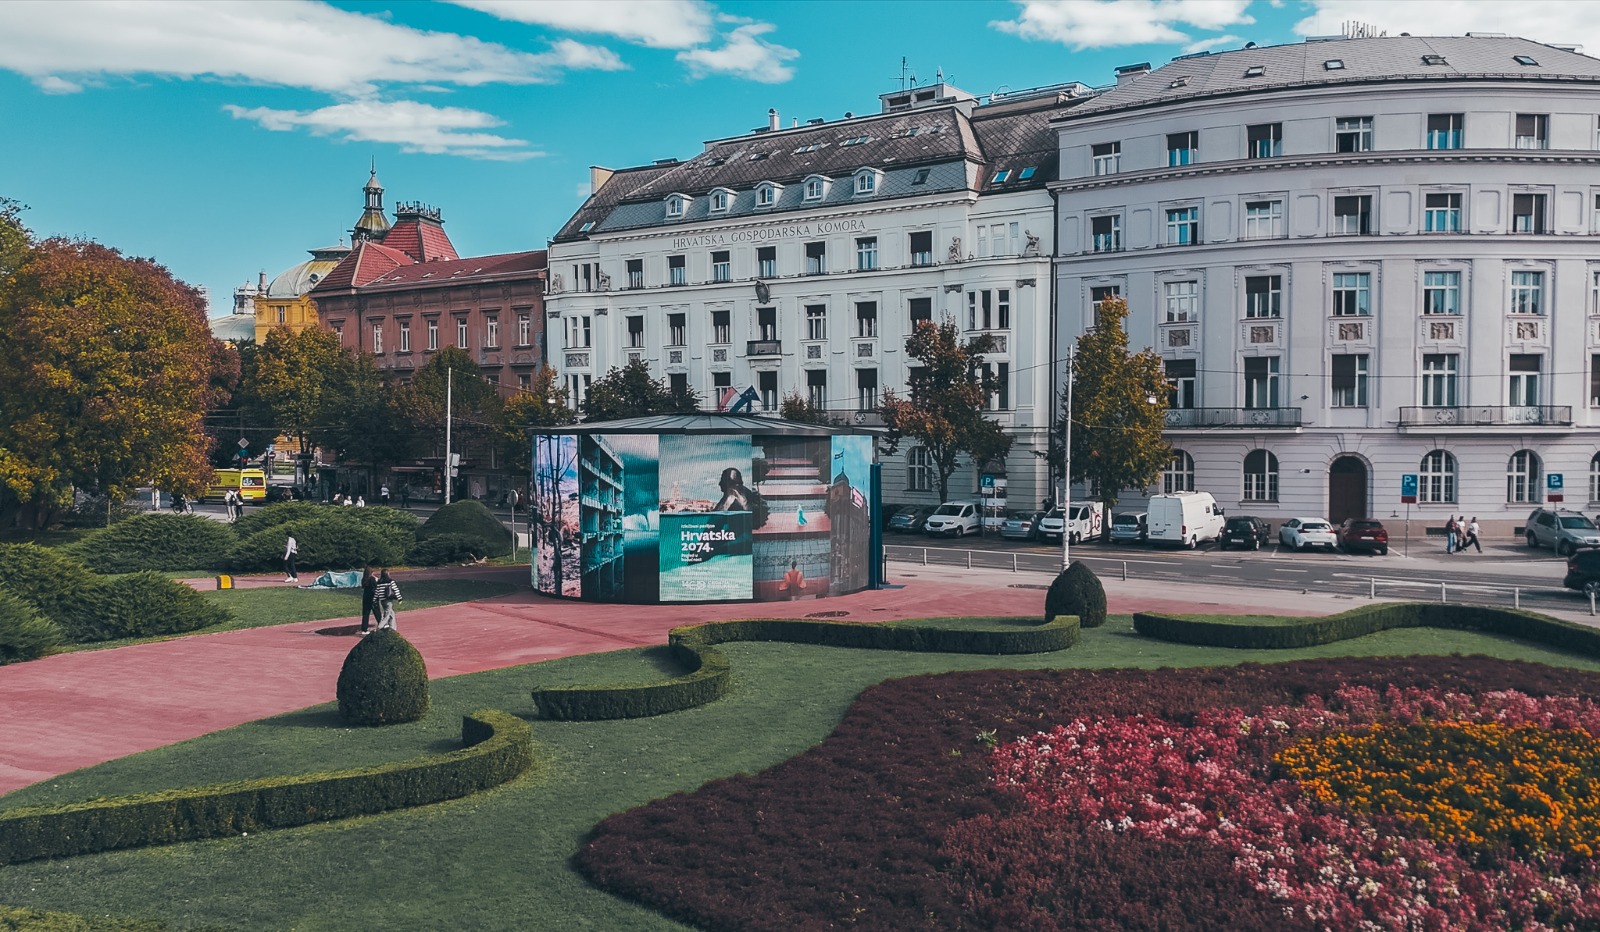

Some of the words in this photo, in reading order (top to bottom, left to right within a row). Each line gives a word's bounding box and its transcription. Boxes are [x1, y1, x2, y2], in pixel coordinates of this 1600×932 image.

[673, 234, 725, 249] HRVATSKA
[731, 225, 811, 243] GOSPODARSKA
[817, 219, 866, 234] KOMORA
[1404, 475, 1412, 486] P
[681, 530, 736, 541] Hrvatska
[681, 542, 714, 553] 2074.
